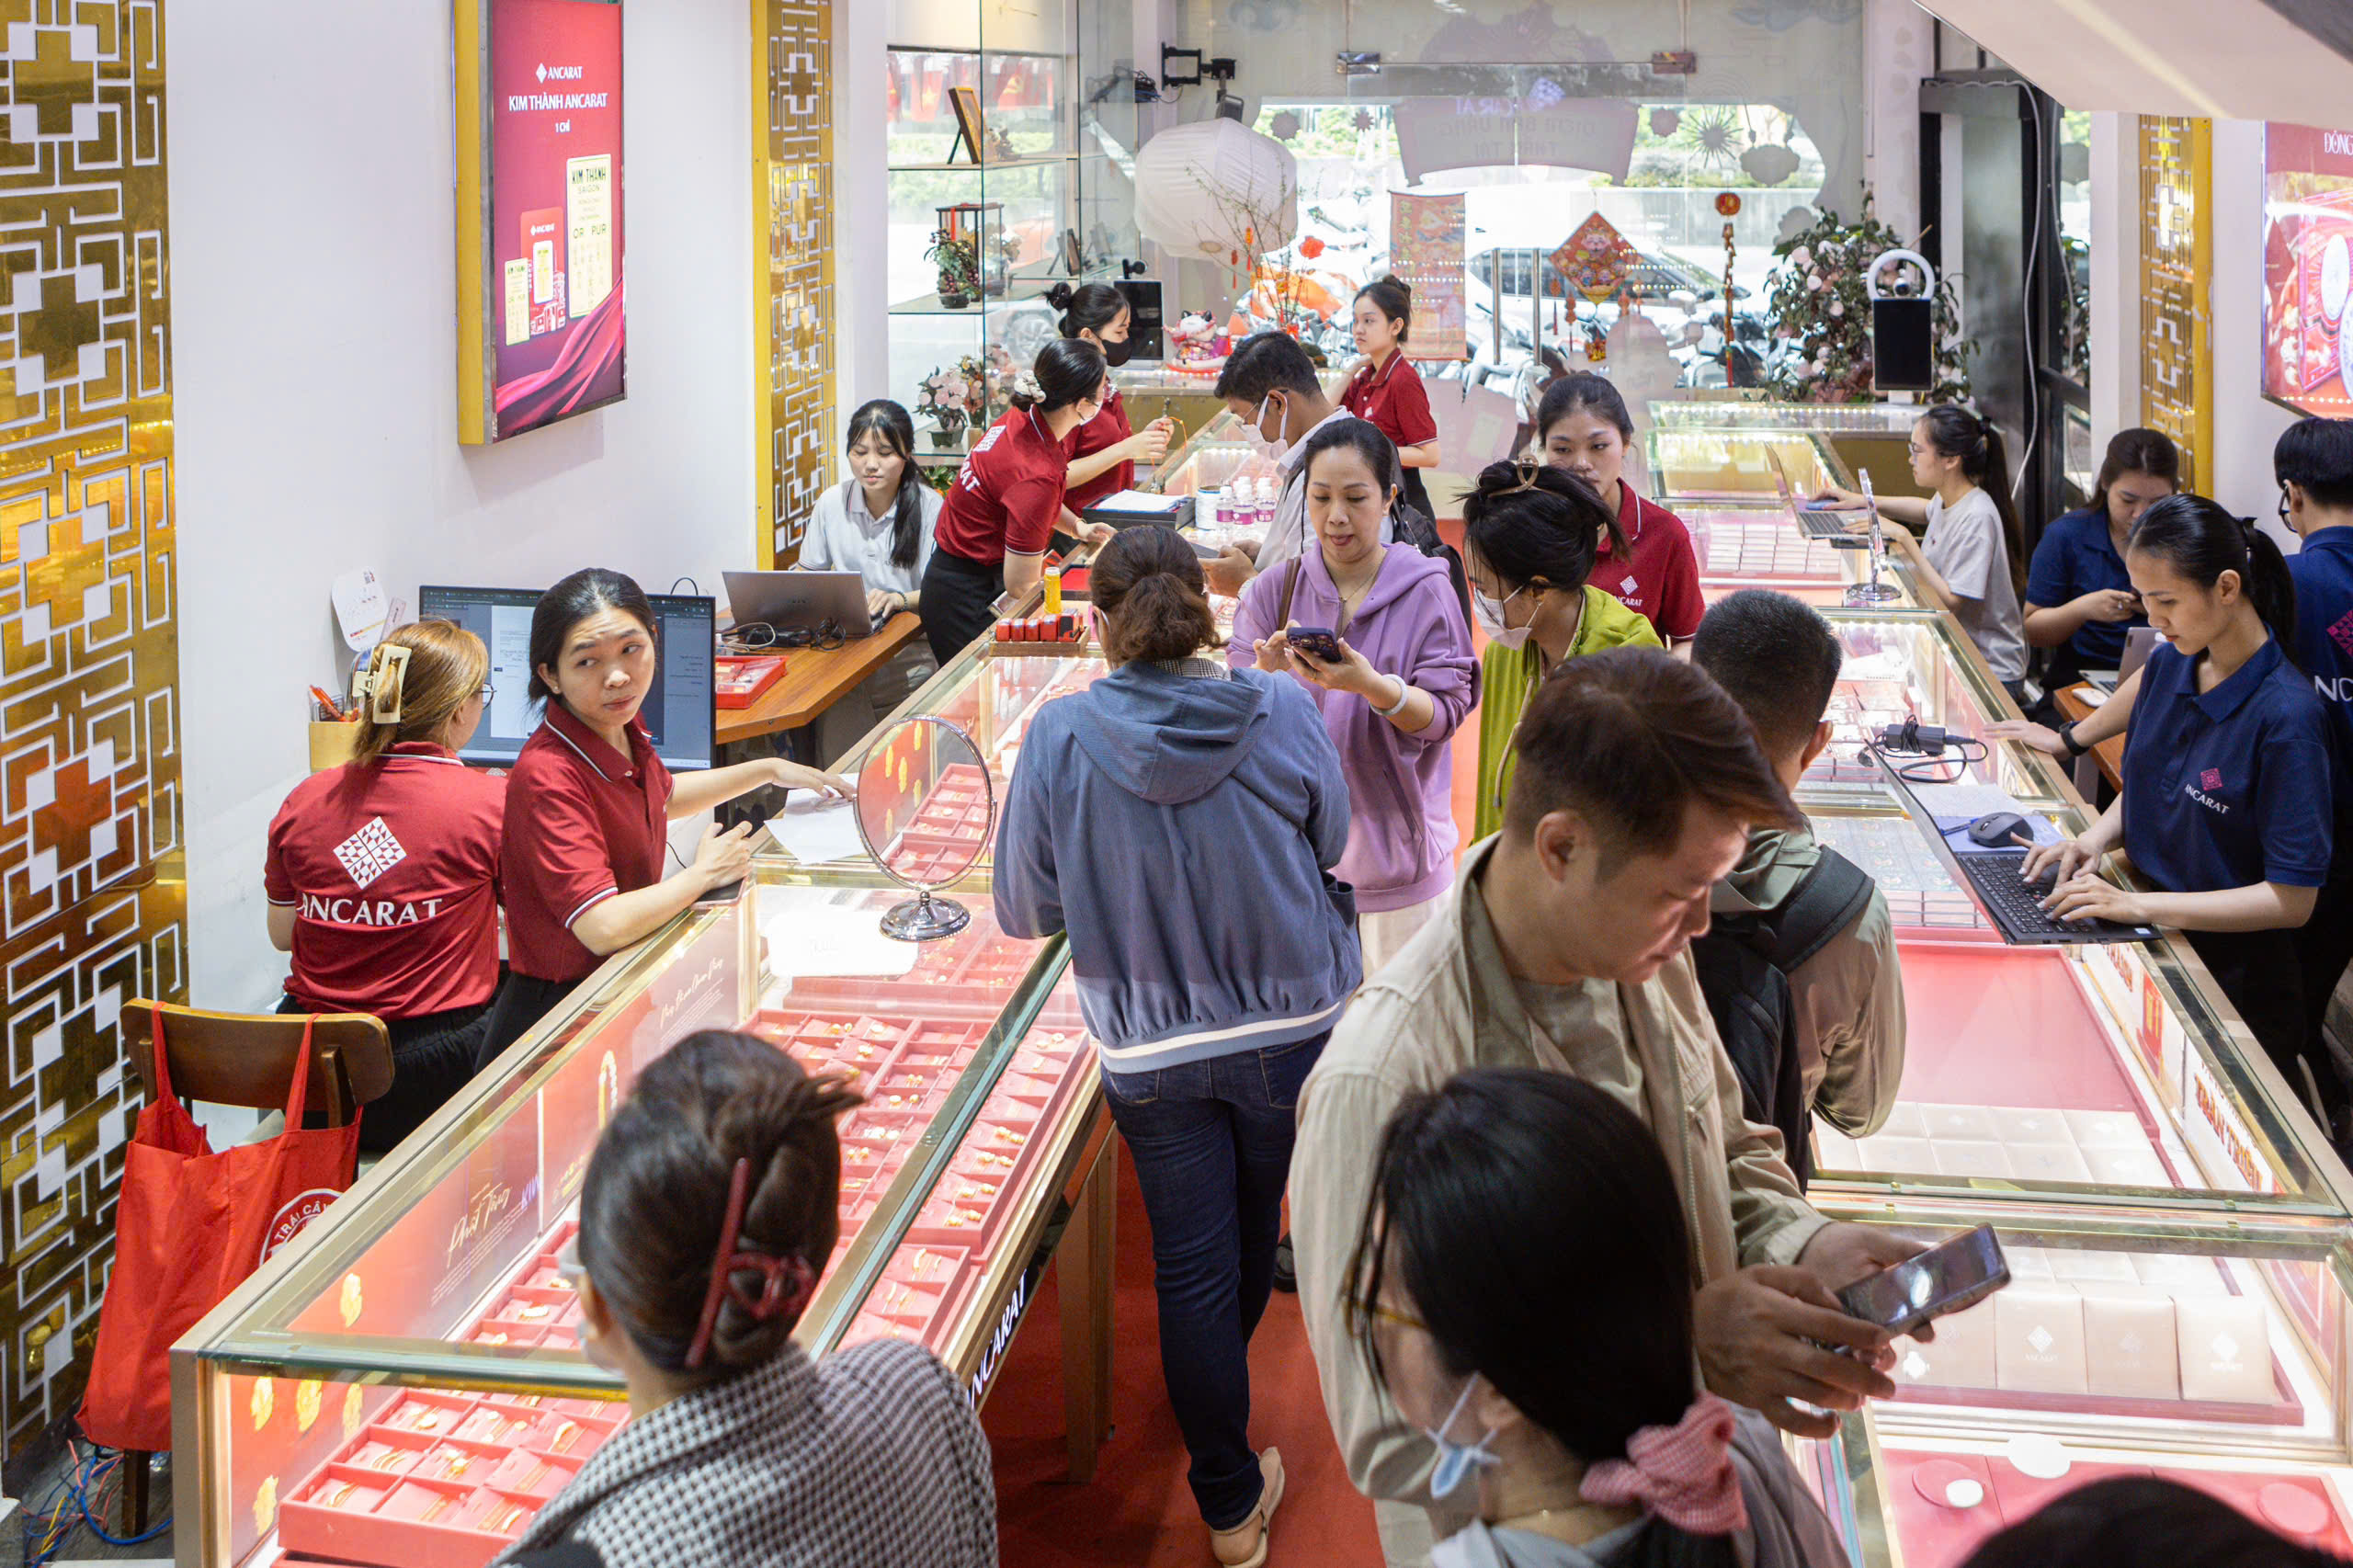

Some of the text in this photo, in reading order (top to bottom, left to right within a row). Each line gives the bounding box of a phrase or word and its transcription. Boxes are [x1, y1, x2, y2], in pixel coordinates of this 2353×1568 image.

[548, 65, 583, 80] ANCARAT
[508, 91, 608, 111] KIM THÀNH ANCARAT
[296, 892, 443, 926] ANCARAT
[966, 1267, 1028, 1411] NCARAT
